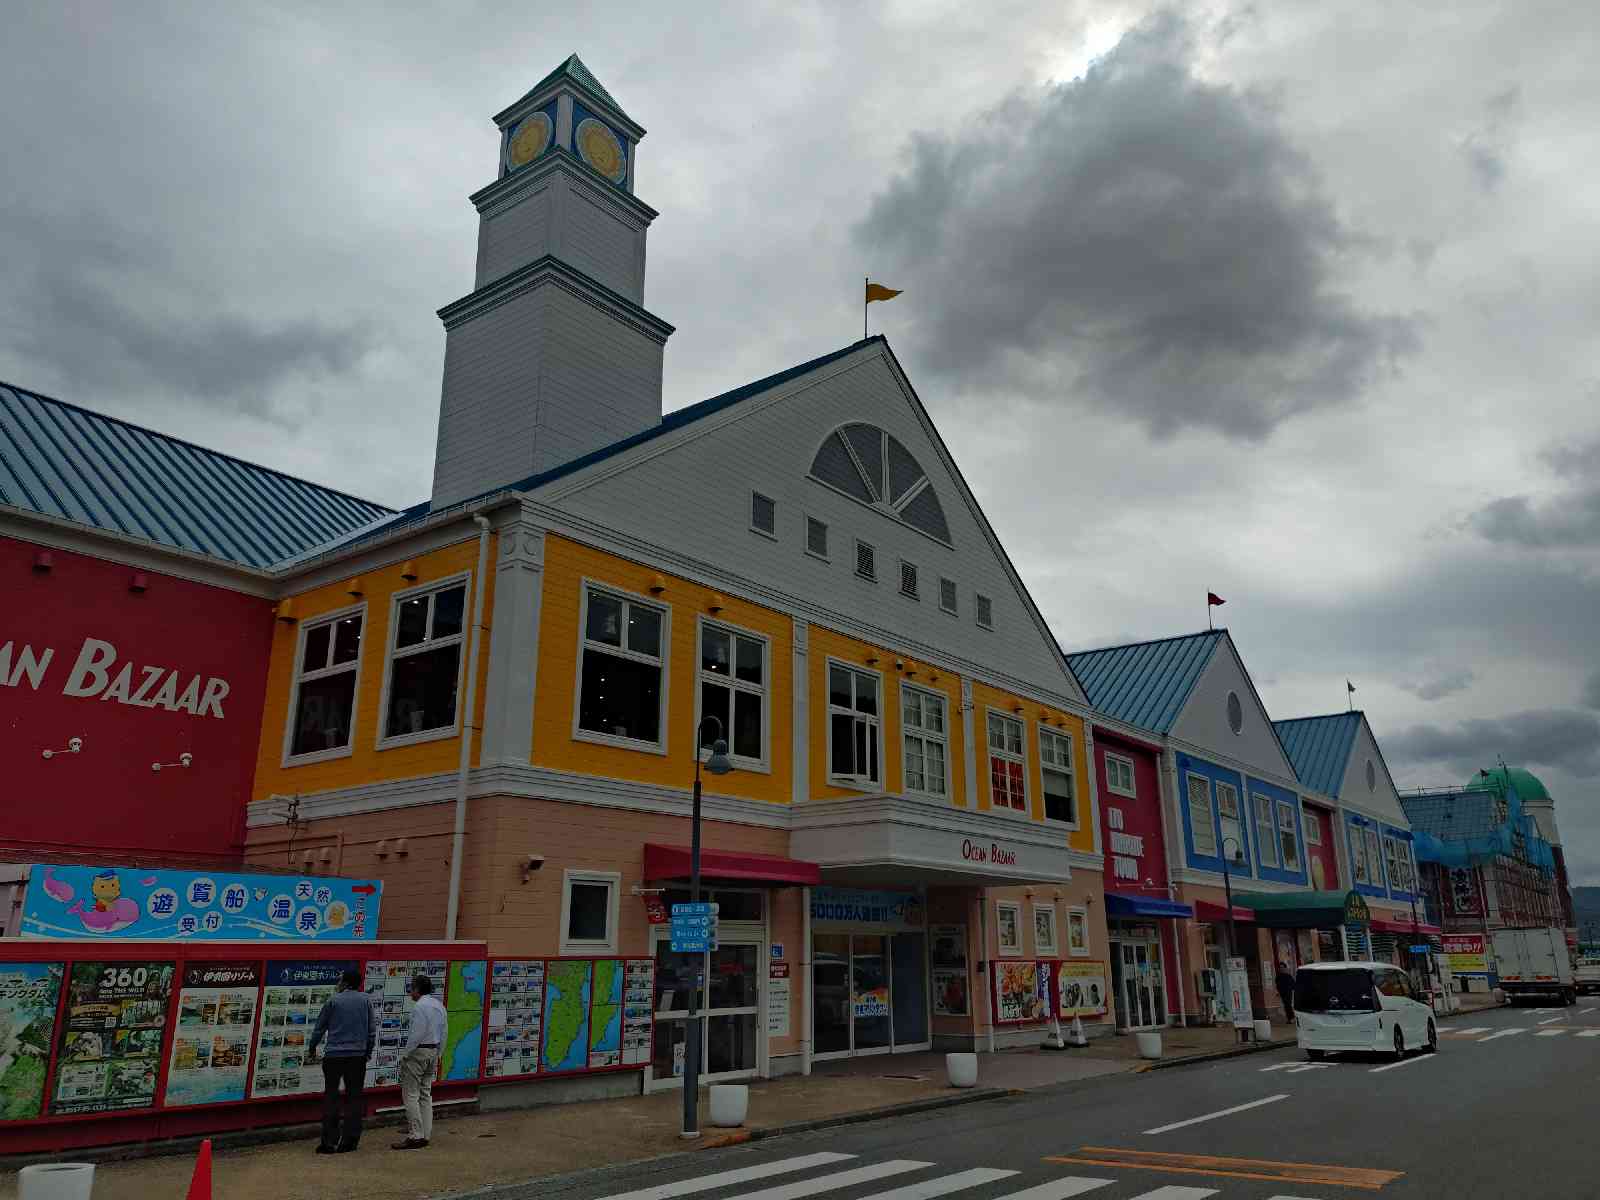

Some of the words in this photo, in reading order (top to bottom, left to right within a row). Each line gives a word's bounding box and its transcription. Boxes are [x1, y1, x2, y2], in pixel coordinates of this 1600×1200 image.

[62, 637, 230, 719] BAZAAR
[962, 839, 989, 863] OCEAN
[991, 843, 1016, 865] BAZAAR
[152, 883, 245, 914] 遊覧船
[298, 883, 329, 905] 天然
[181, 914, 218, 932] 受付
[272, 899, 317, 931] 温泉
[100, 967, 148, 988] 360
